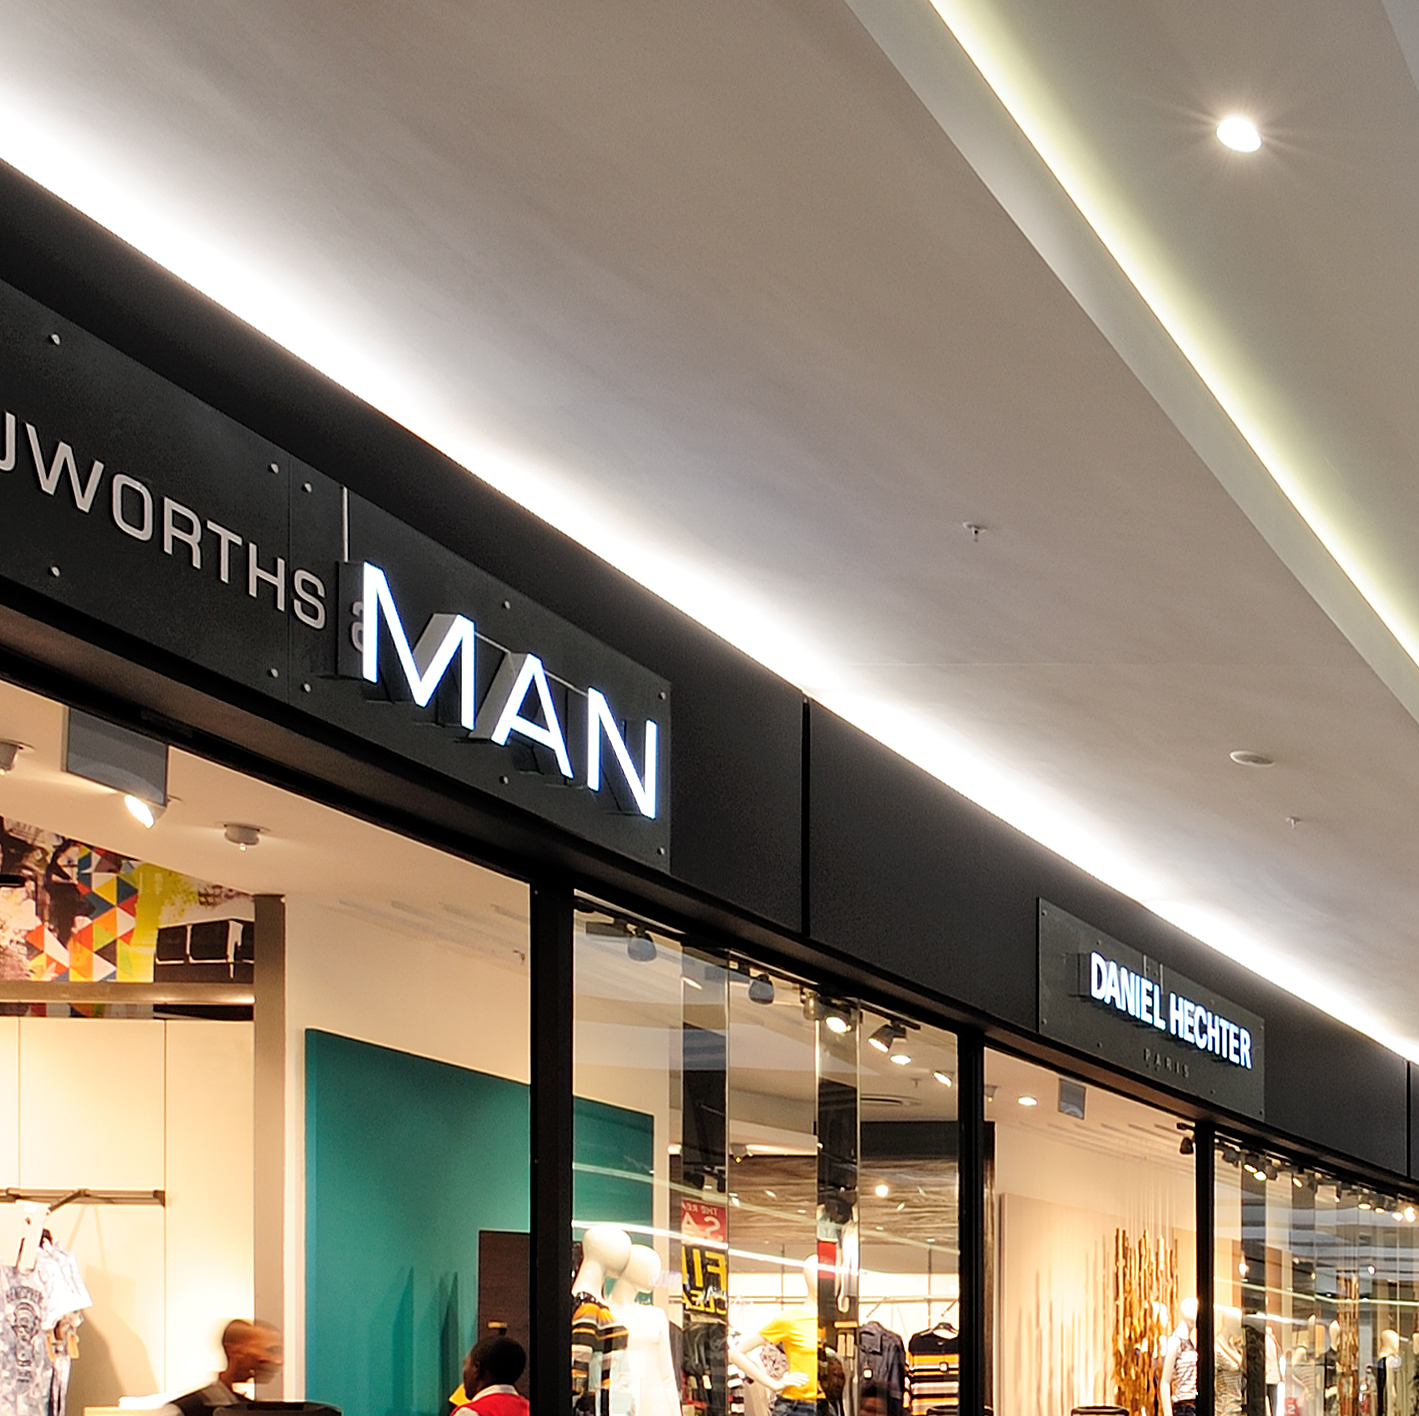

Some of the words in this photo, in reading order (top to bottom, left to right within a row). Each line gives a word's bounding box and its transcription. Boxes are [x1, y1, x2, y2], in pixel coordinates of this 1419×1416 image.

[362, 561, 658, 820] MAN
[1091, 951, 1166, 1031] DANIEL
[1169, 991, 1253, 1070] HECHTER
[1144, 1048, 1190, 1079] PARIS
